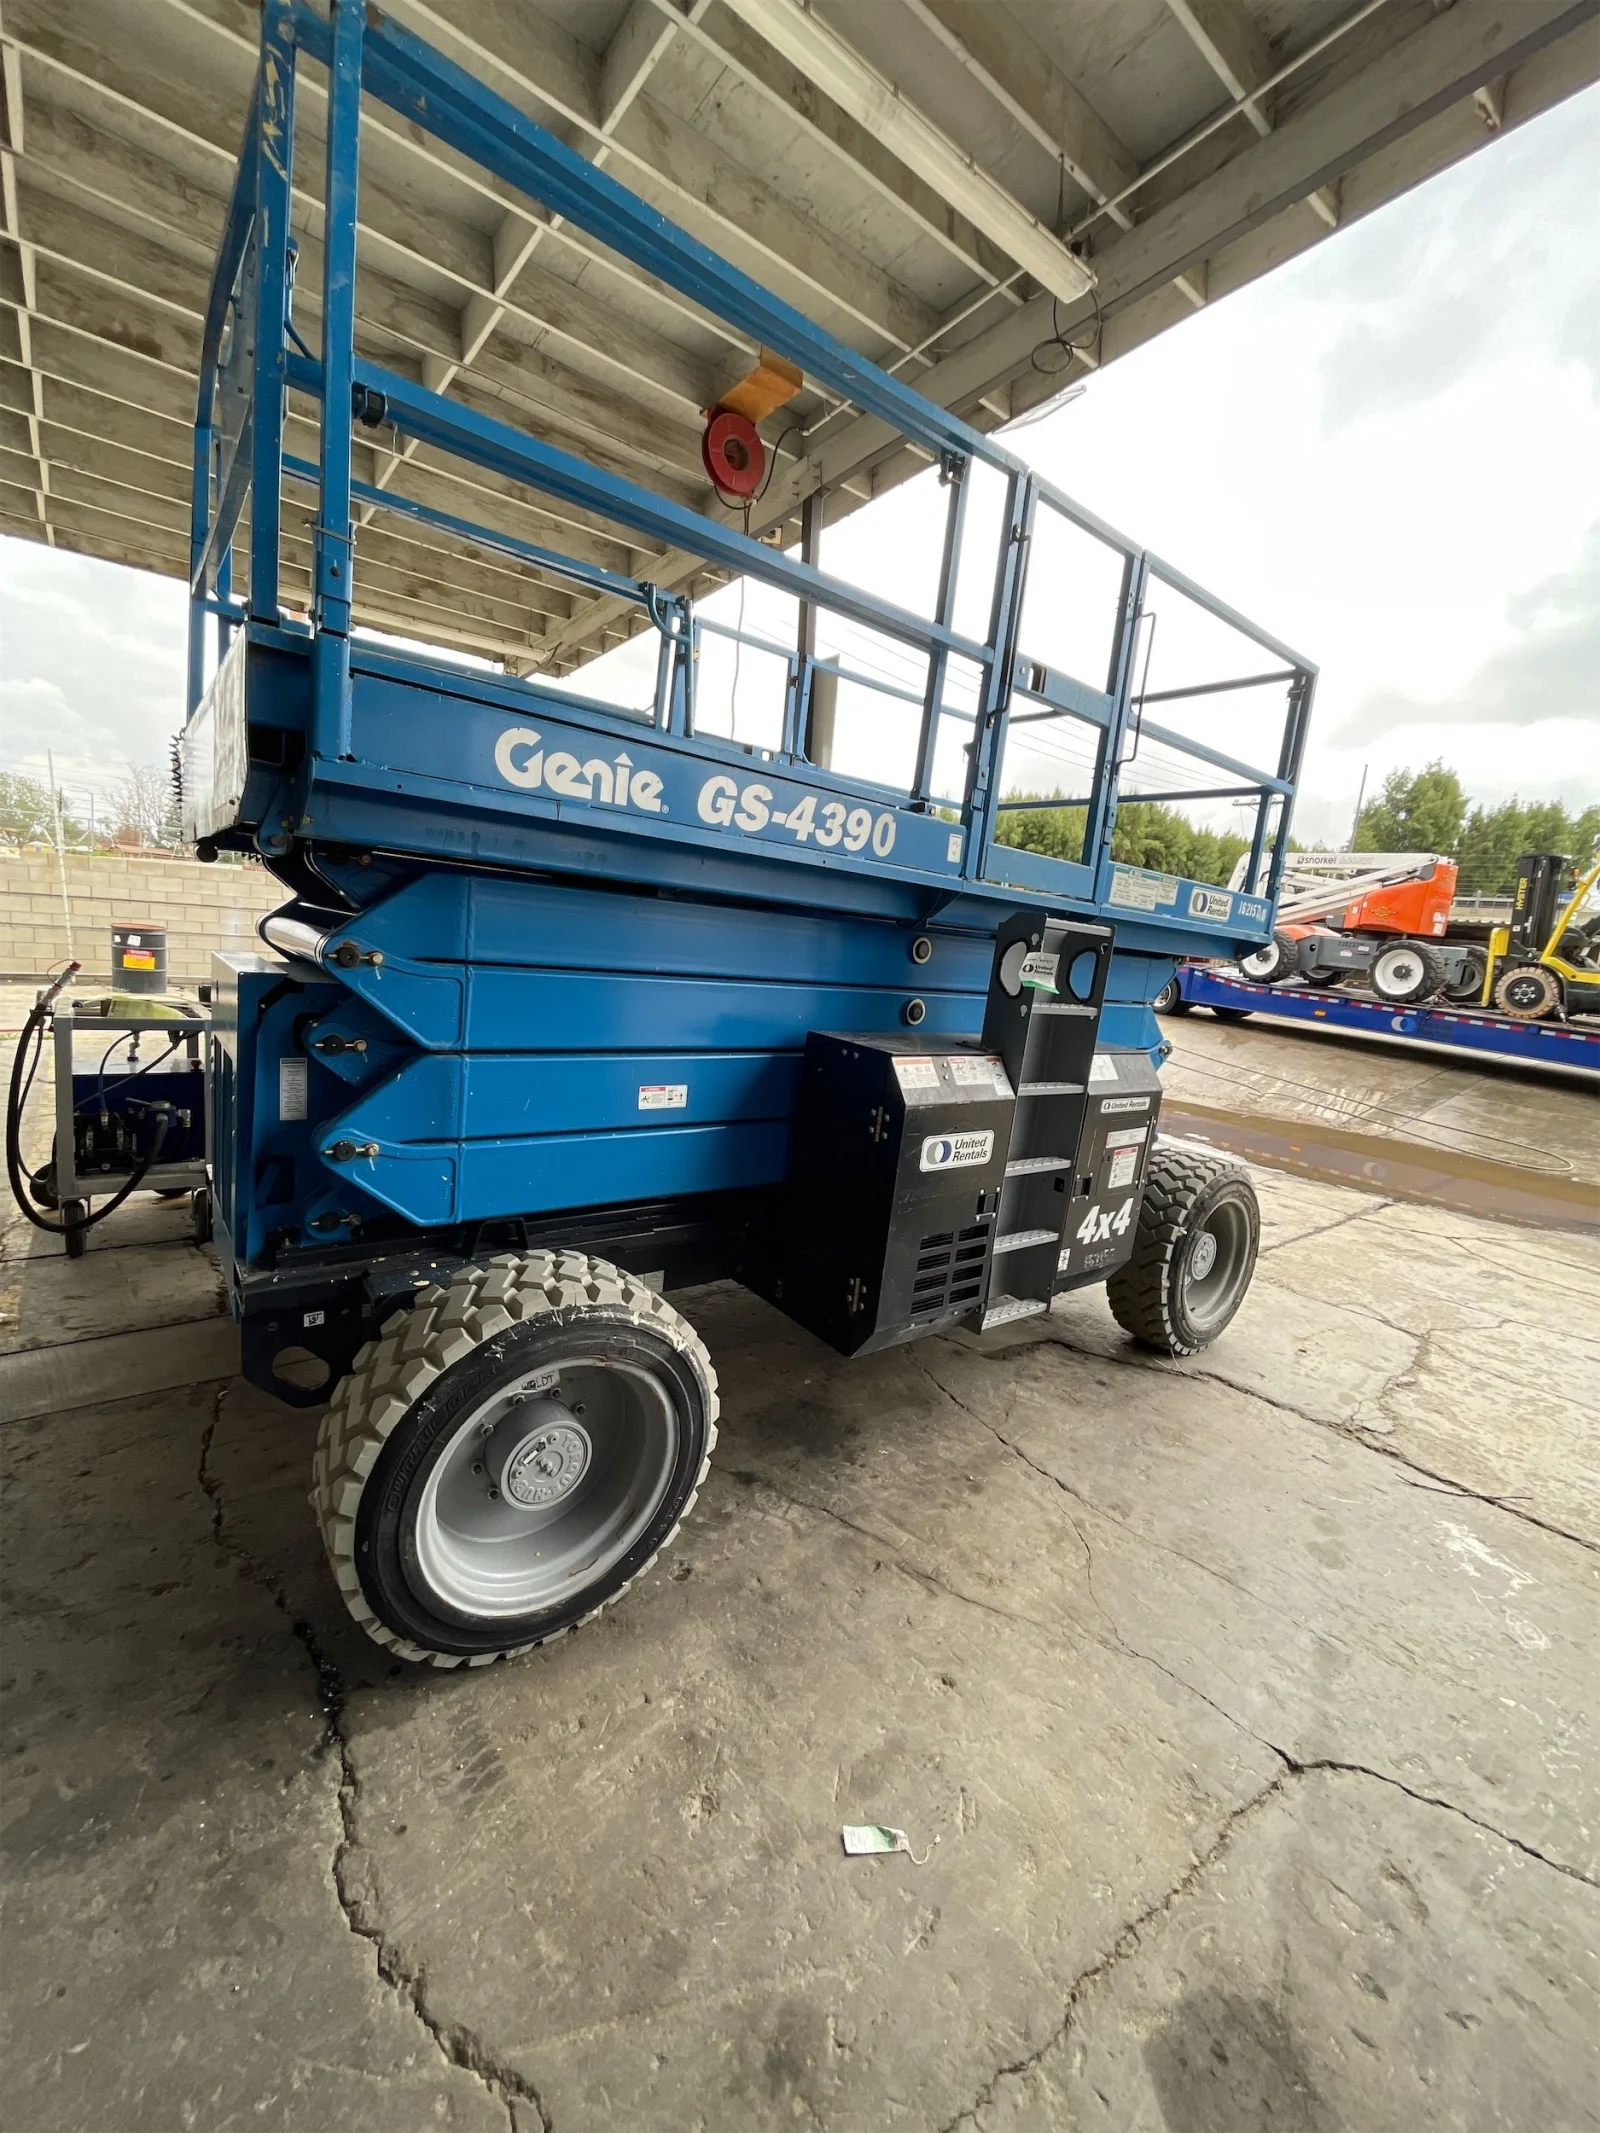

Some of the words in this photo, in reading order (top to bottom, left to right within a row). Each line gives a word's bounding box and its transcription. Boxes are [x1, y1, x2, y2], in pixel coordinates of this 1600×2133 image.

[494, 727, 665, 813] Genie
[697, 775, 897, 858] GS-4390
[1304, 856, 1337, 865] snorkel
[1208, 895, 1230, 907] United
[1206, 905, 1229, 918] Rentals
[1111, 1101, 1129, 1110] United
[1129, 1100, 1148, 1108] Rentals
[954, 1136, 988, 1150] United
[952, 1148, 988, 1162] Rentals
[1076, 1197, 1134, 1245] 4x4
